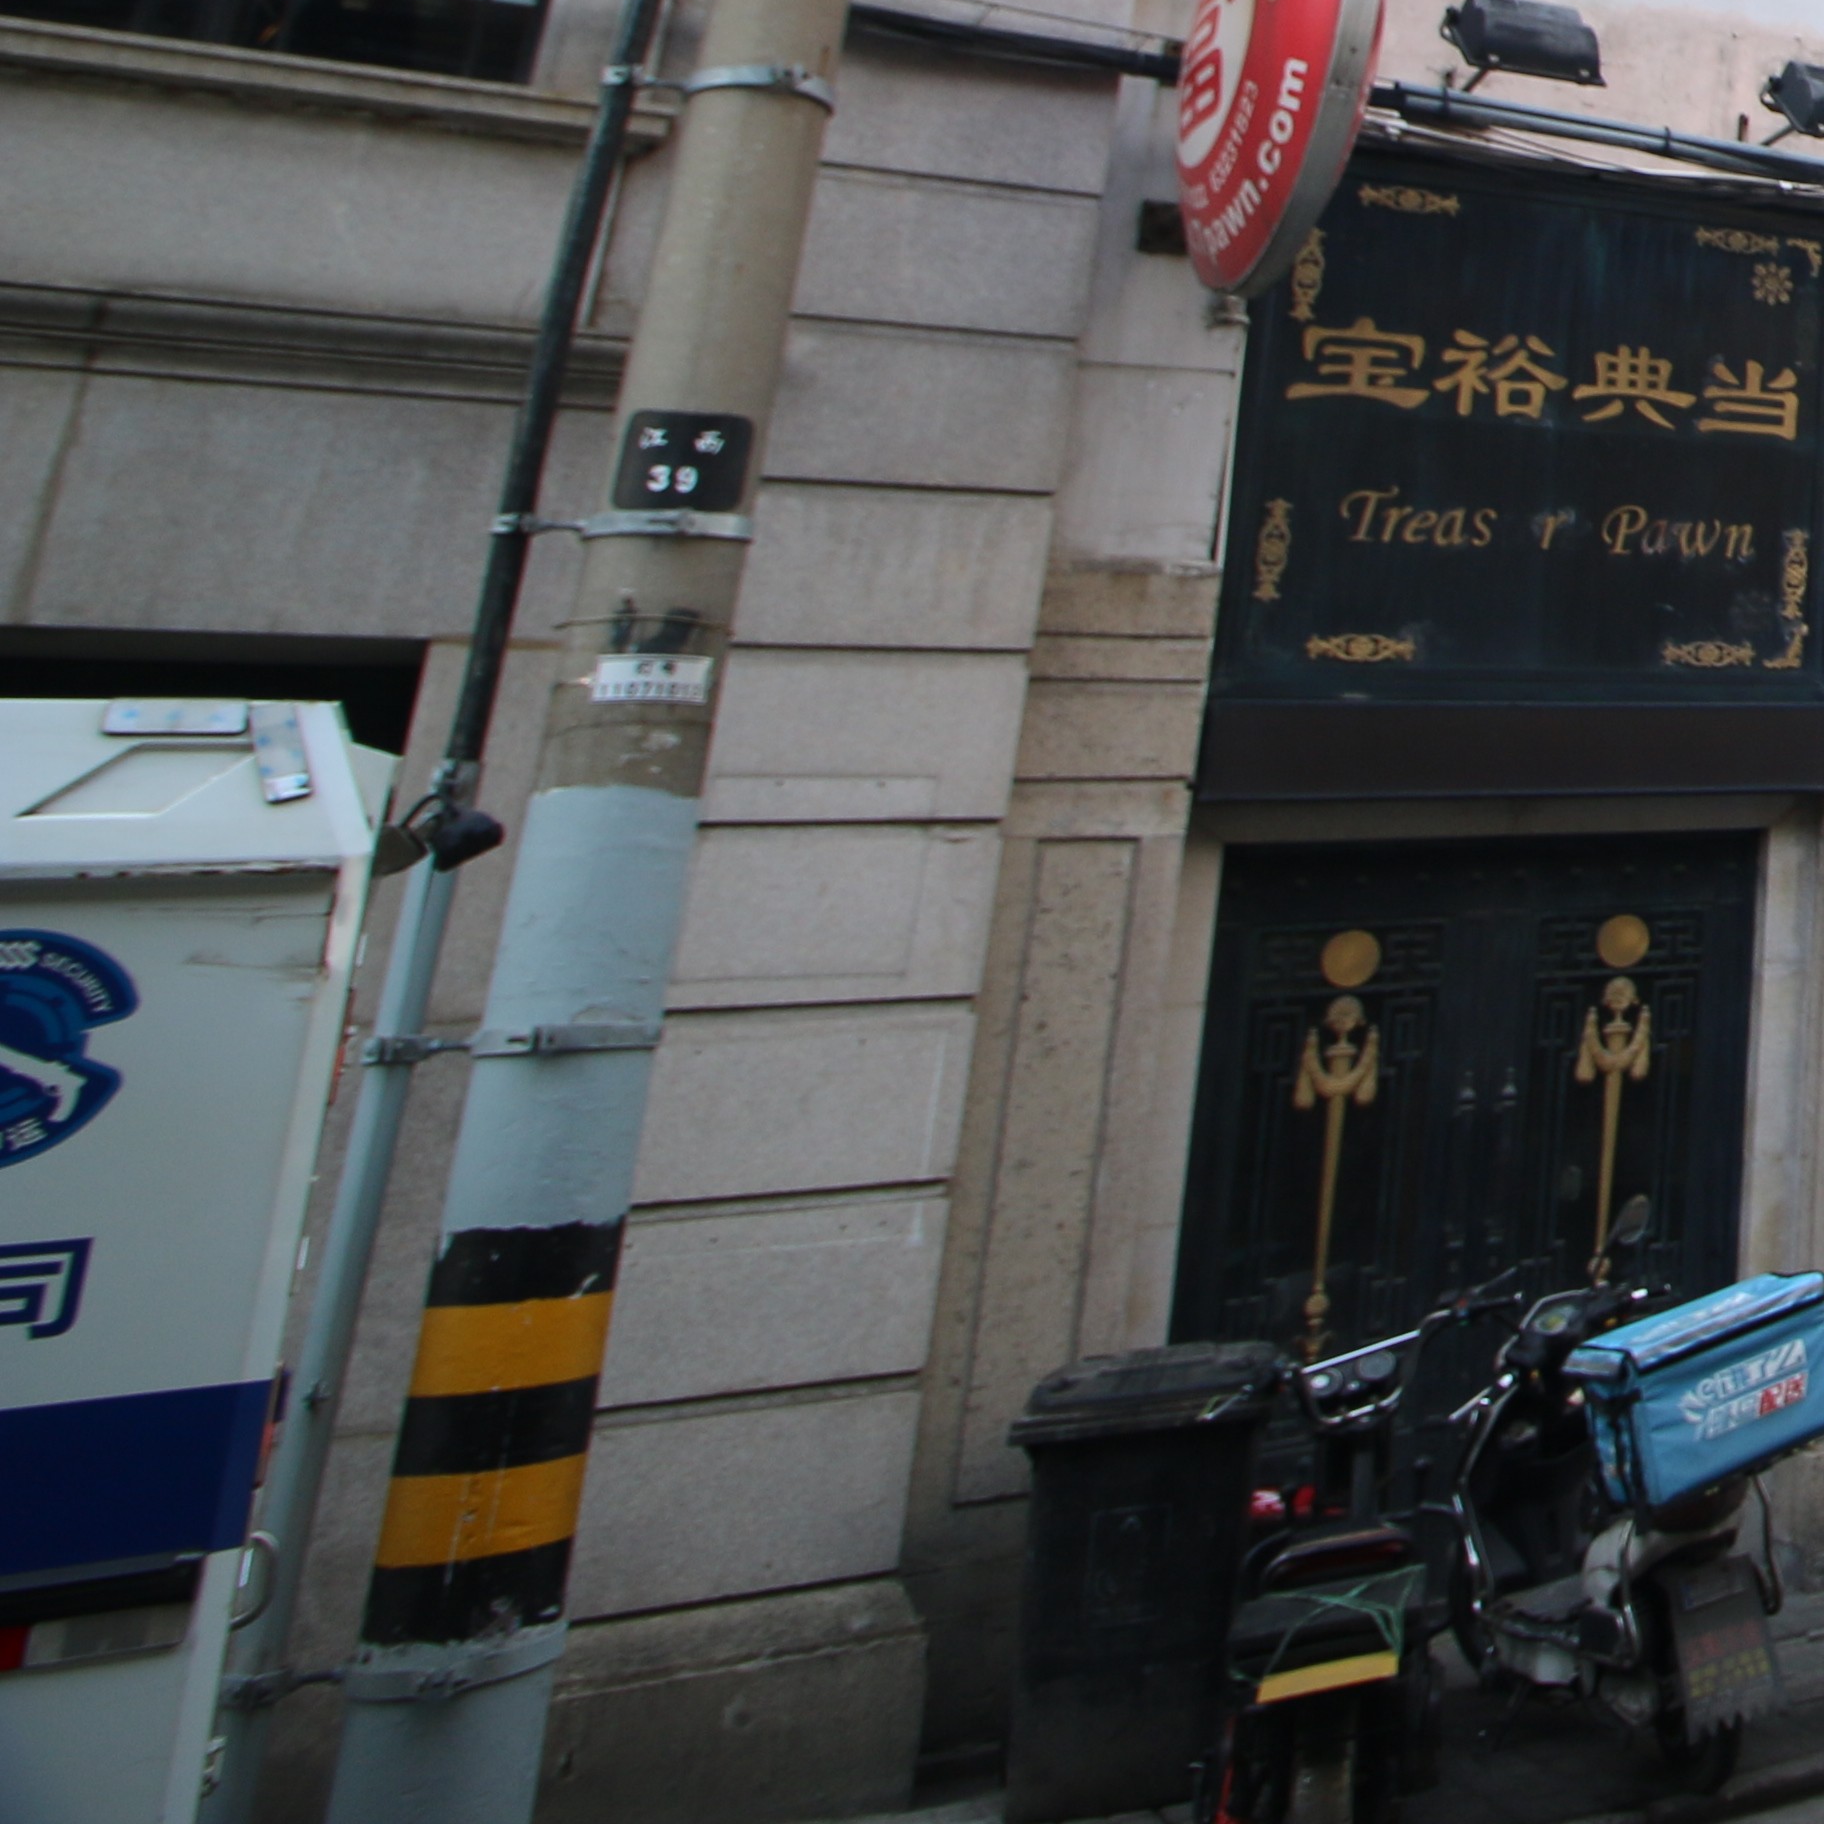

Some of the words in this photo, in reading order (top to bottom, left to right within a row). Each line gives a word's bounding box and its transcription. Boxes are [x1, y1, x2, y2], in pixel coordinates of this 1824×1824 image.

[1285, 317, 1799, 441] 宝裕典当
[645, 464, 699, 494] 39
[1341, 486, 1498, 547] Treas
[1601, 504, 1756, 558] Pawn
